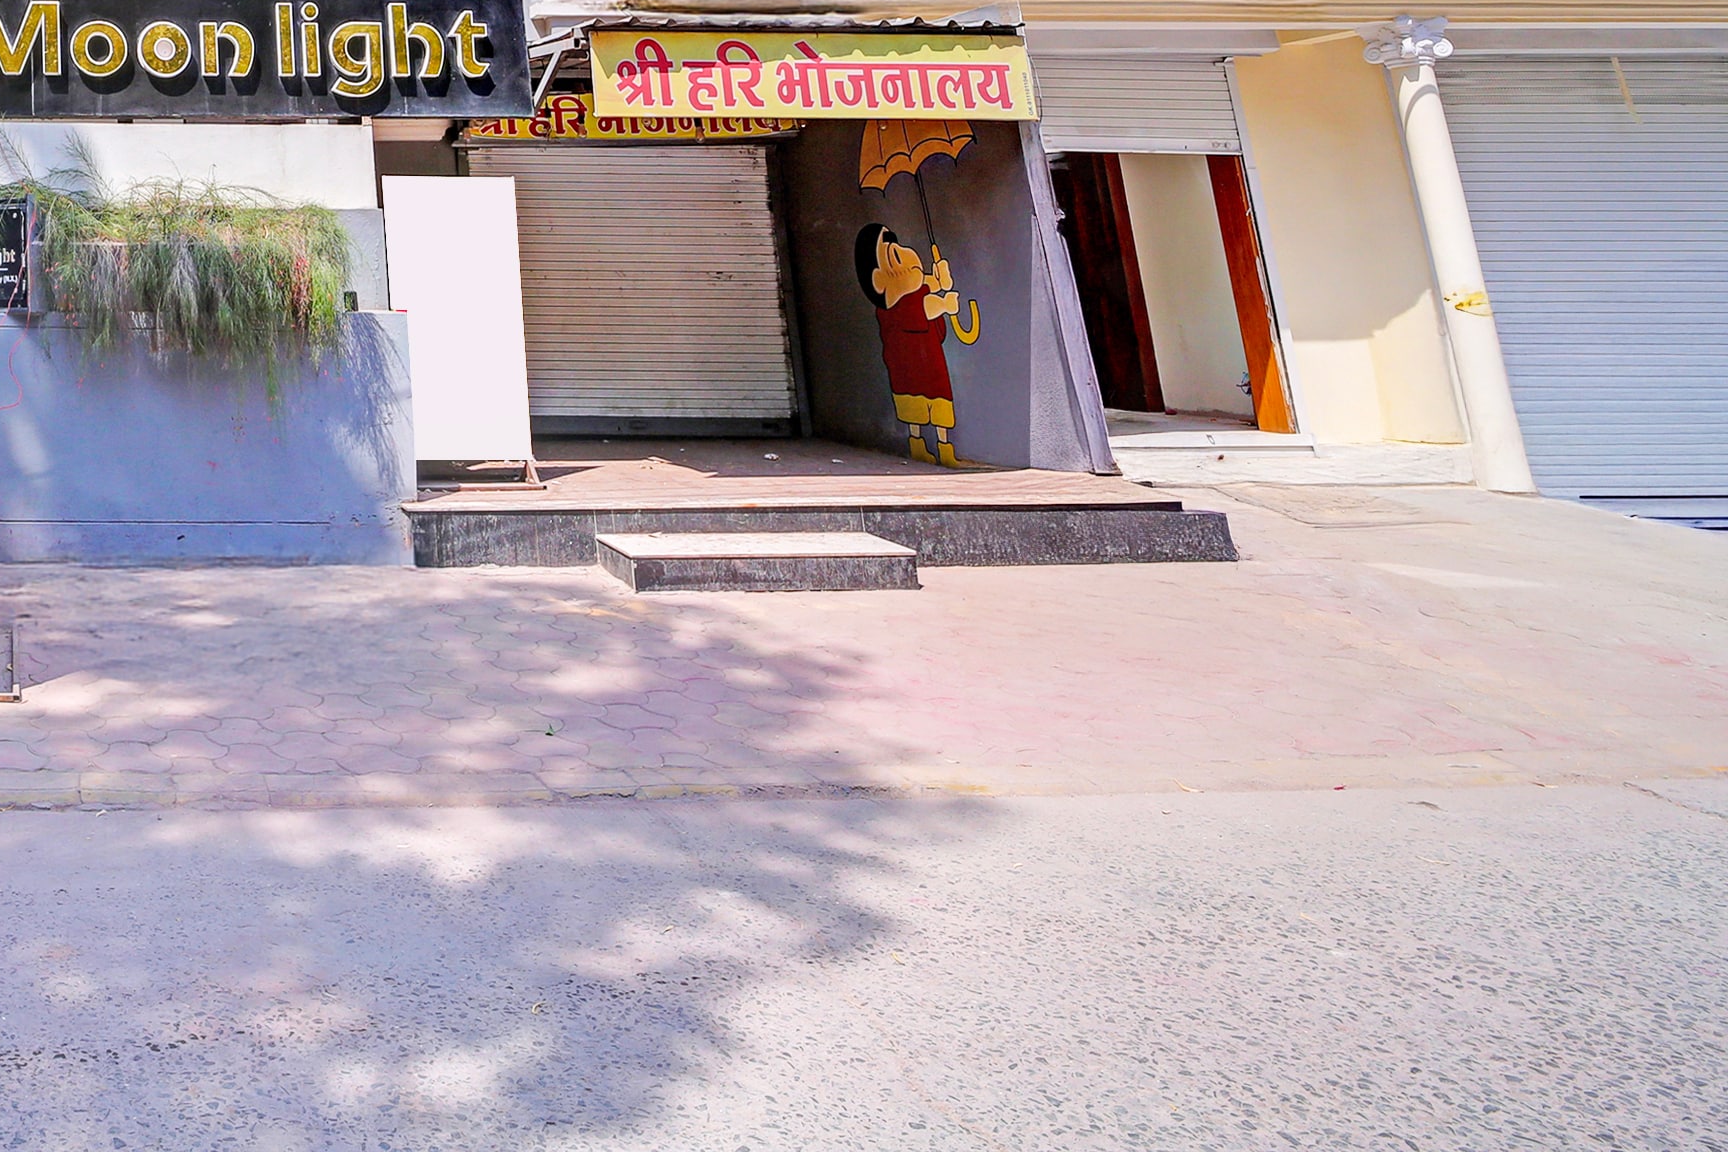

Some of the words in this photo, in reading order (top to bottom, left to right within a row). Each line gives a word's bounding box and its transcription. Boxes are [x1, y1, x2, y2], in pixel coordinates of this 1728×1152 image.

[616, 38, 674, 107] श्री
[682, 40, 765, 111] हरि
[775, 40, 1014, 110] भोजनालय
